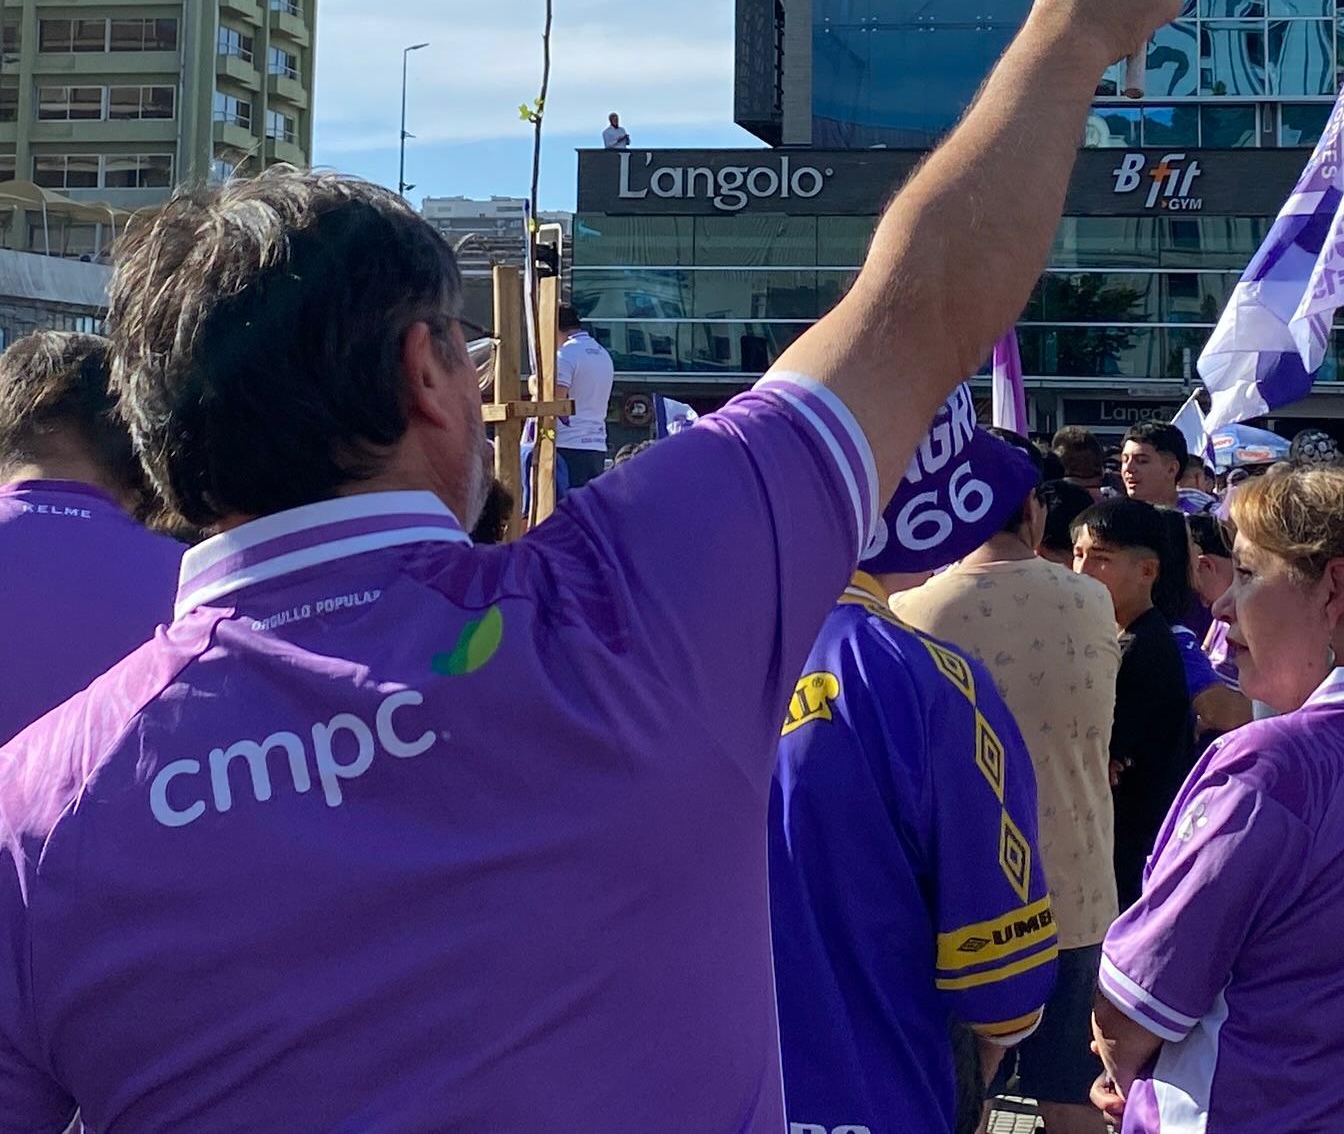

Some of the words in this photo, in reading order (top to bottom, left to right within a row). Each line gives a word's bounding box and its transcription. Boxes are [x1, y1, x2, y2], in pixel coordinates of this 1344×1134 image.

[618, 153, 824, 211] L'angolo
[1168, 198, 1203, 210] GYM
[22, 504, 92, 519] KELME
[250, 604, 312, 632] ORGULLO
[150, 690, 437, 827] cmpc
